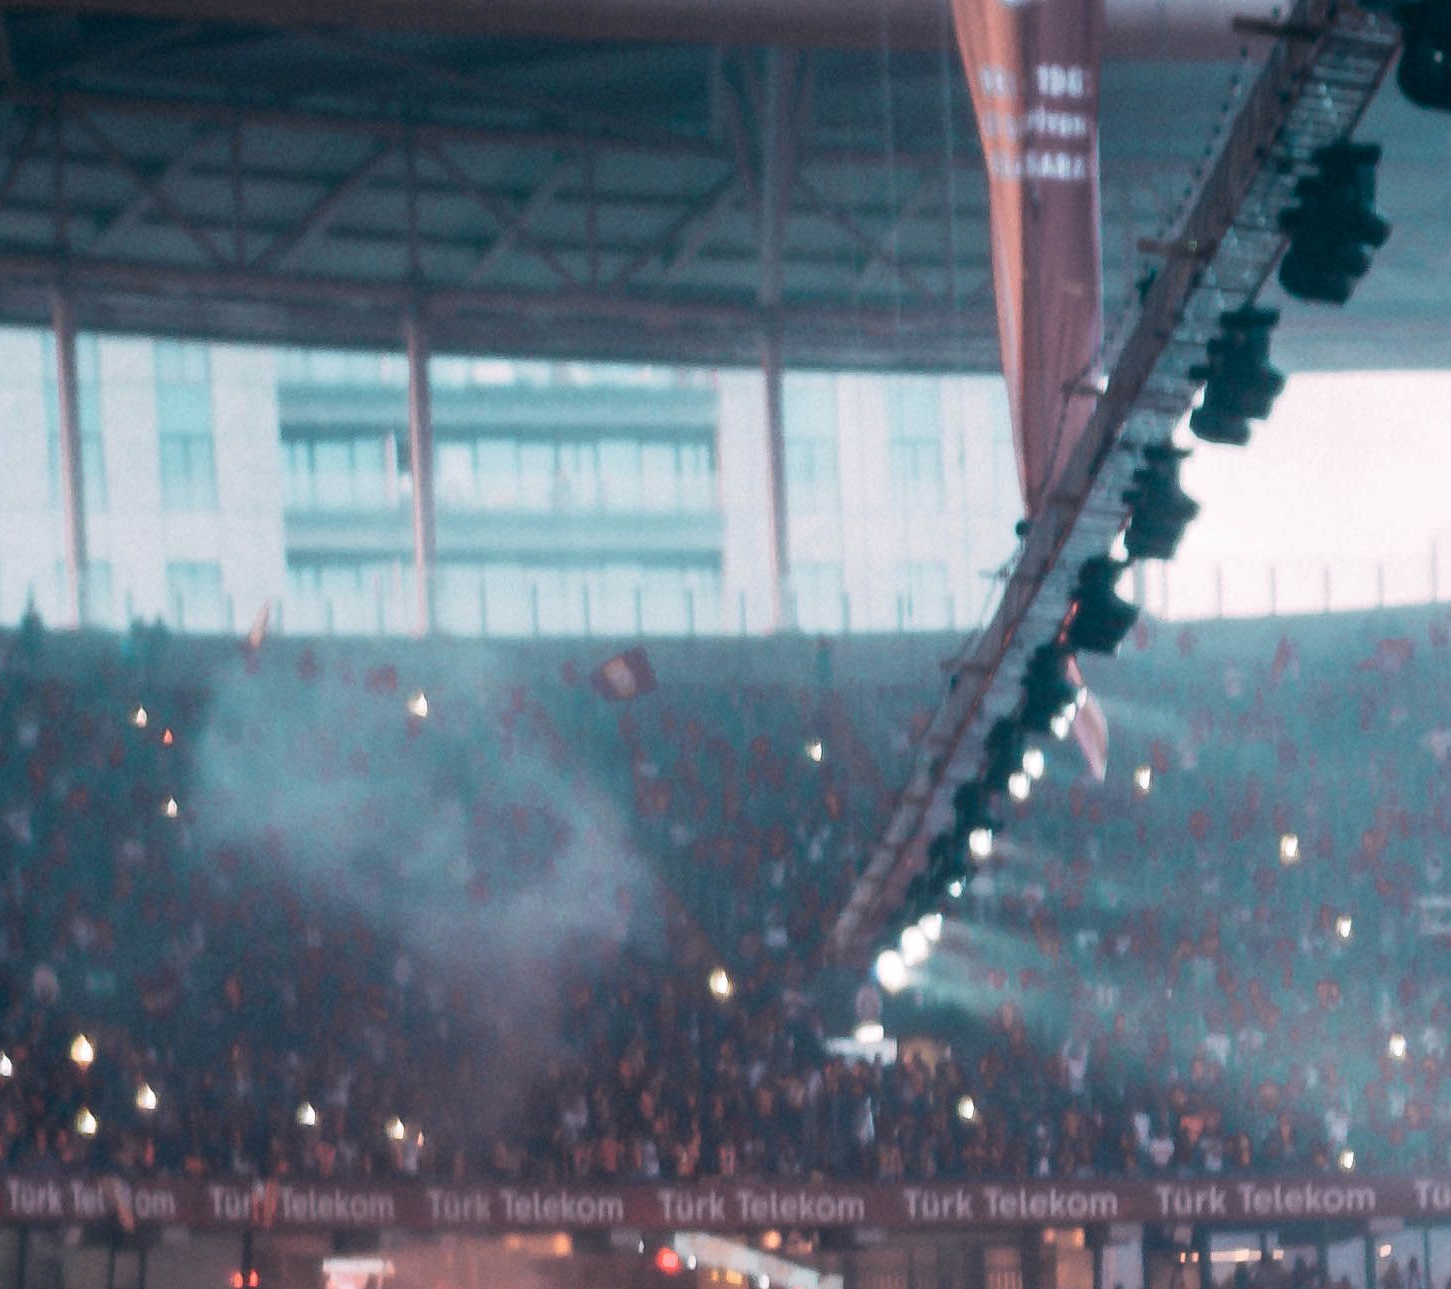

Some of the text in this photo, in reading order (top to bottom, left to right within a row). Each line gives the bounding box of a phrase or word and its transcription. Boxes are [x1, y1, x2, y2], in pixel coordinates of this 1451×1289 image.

[6, 1176, 178, 1218] Türk Telom
[209, 1183, 397, 1222] Tür Telekom
[429, 1189, 625, 1224] Türk Telekom
[658, 1189, 867, 1224] Türk Telekom
[902, 1184, 1120, 1221] Türk Telekom
[1155, 1181, 1378, 1217] Türk Telekom
